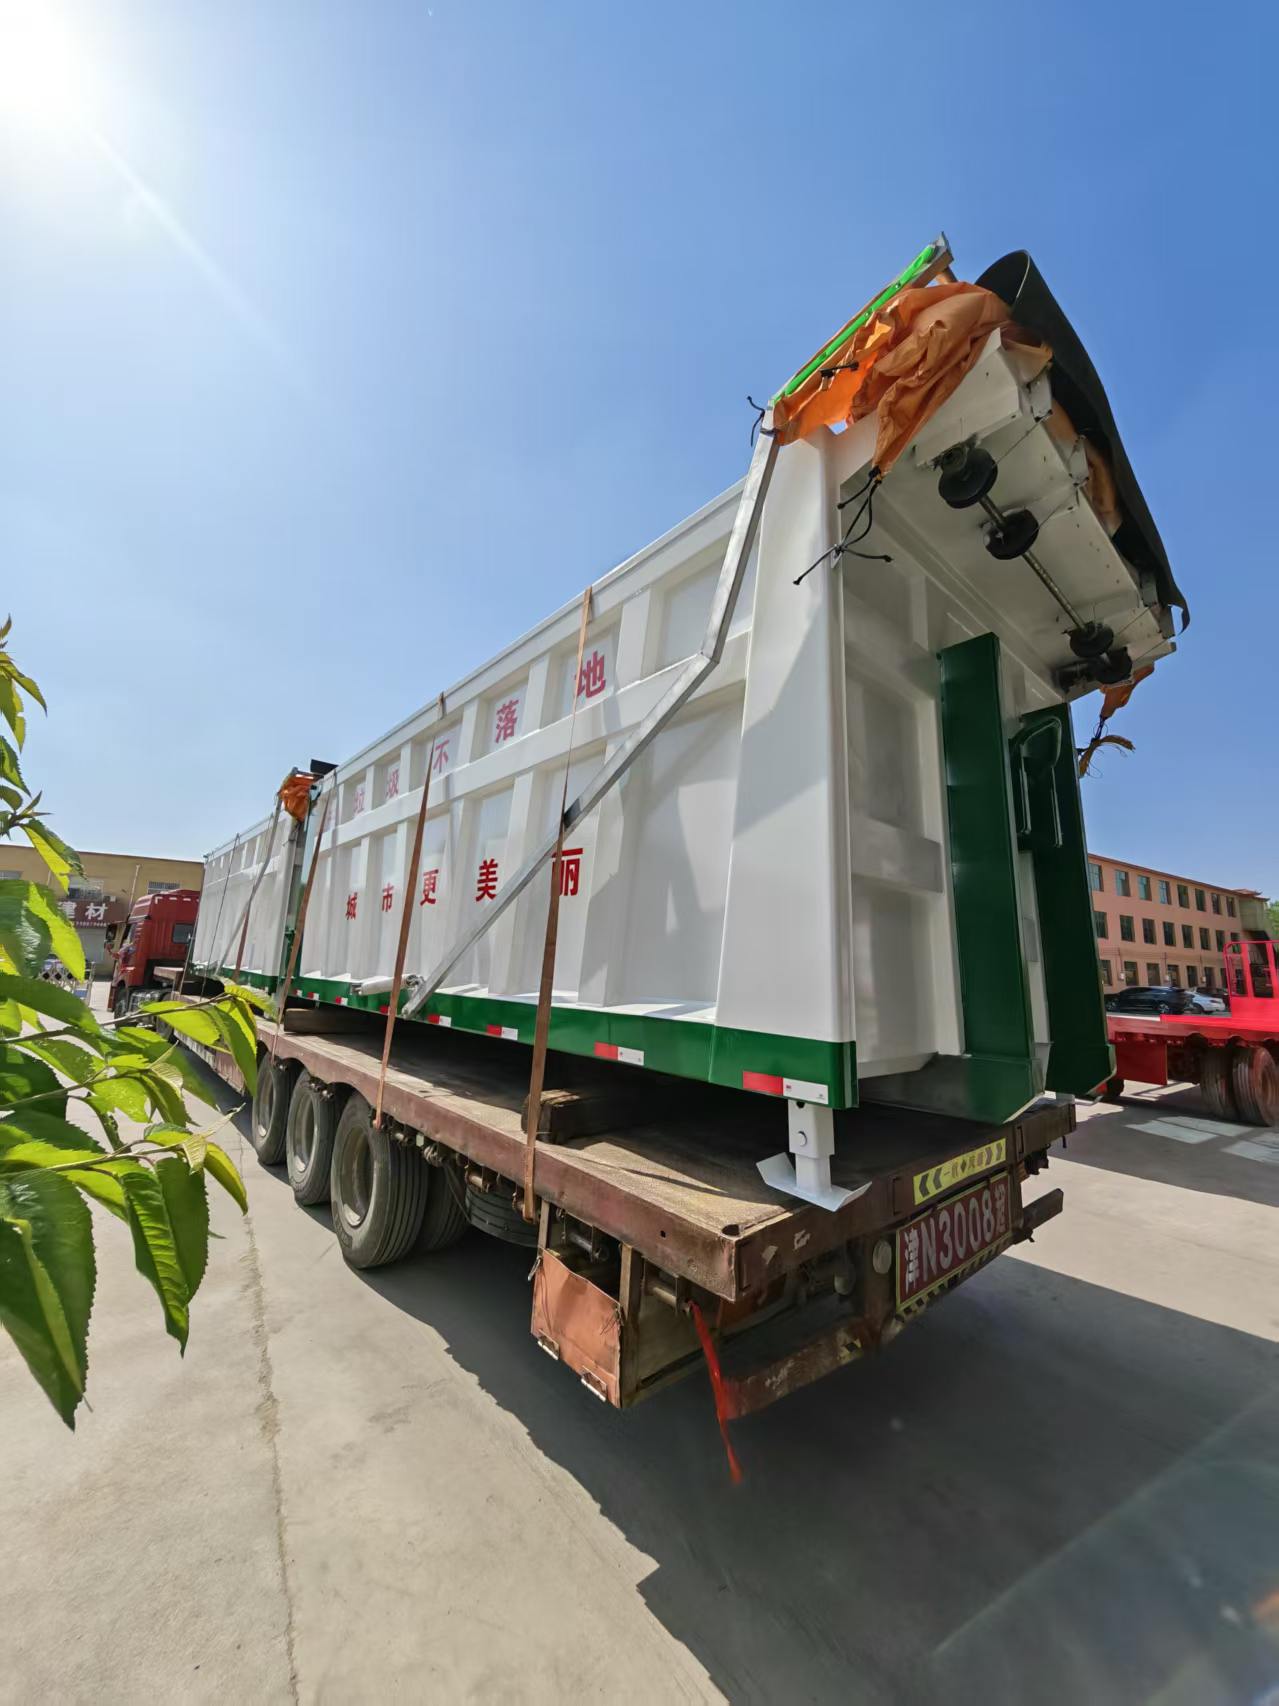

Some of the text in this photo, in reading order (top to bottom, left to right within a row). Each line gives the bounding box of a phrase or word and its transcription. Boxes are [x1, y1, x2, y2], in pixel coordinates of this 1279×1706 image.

[345, 848, 583, 920] 城市更美丽
